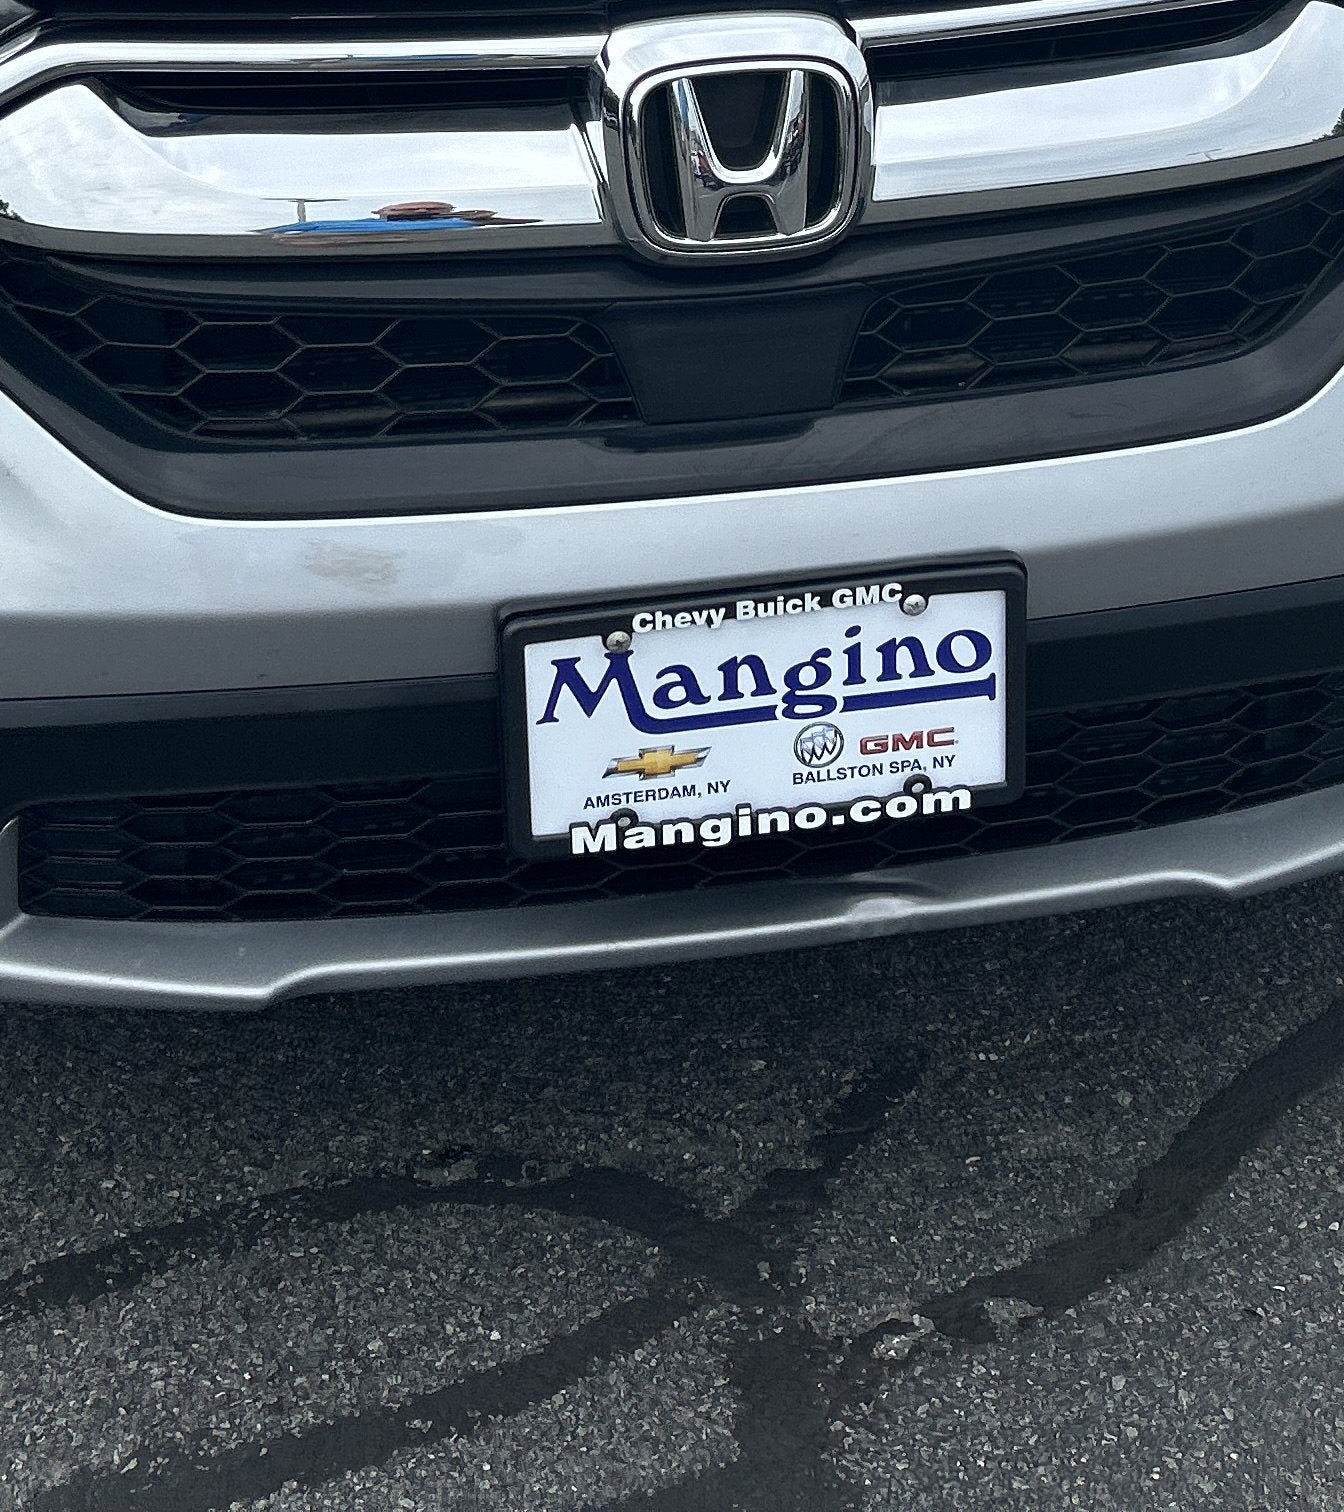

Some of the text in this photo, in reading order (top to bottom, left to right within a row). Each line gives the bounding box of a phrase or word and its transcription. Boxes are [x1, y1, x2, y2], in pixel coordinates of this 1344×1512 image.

[632, 583, 903, 634] Chevy Buick GMC
[536, 625, 996, 735] Mangino
[859, 726, 957, 756] GMC
[792, 754, 956, 786] BALLSTON SPA, NY
[583, 779, 731, 810] AMSTERDAM, NY
[571, 787, 972, 855] Mangino.com
